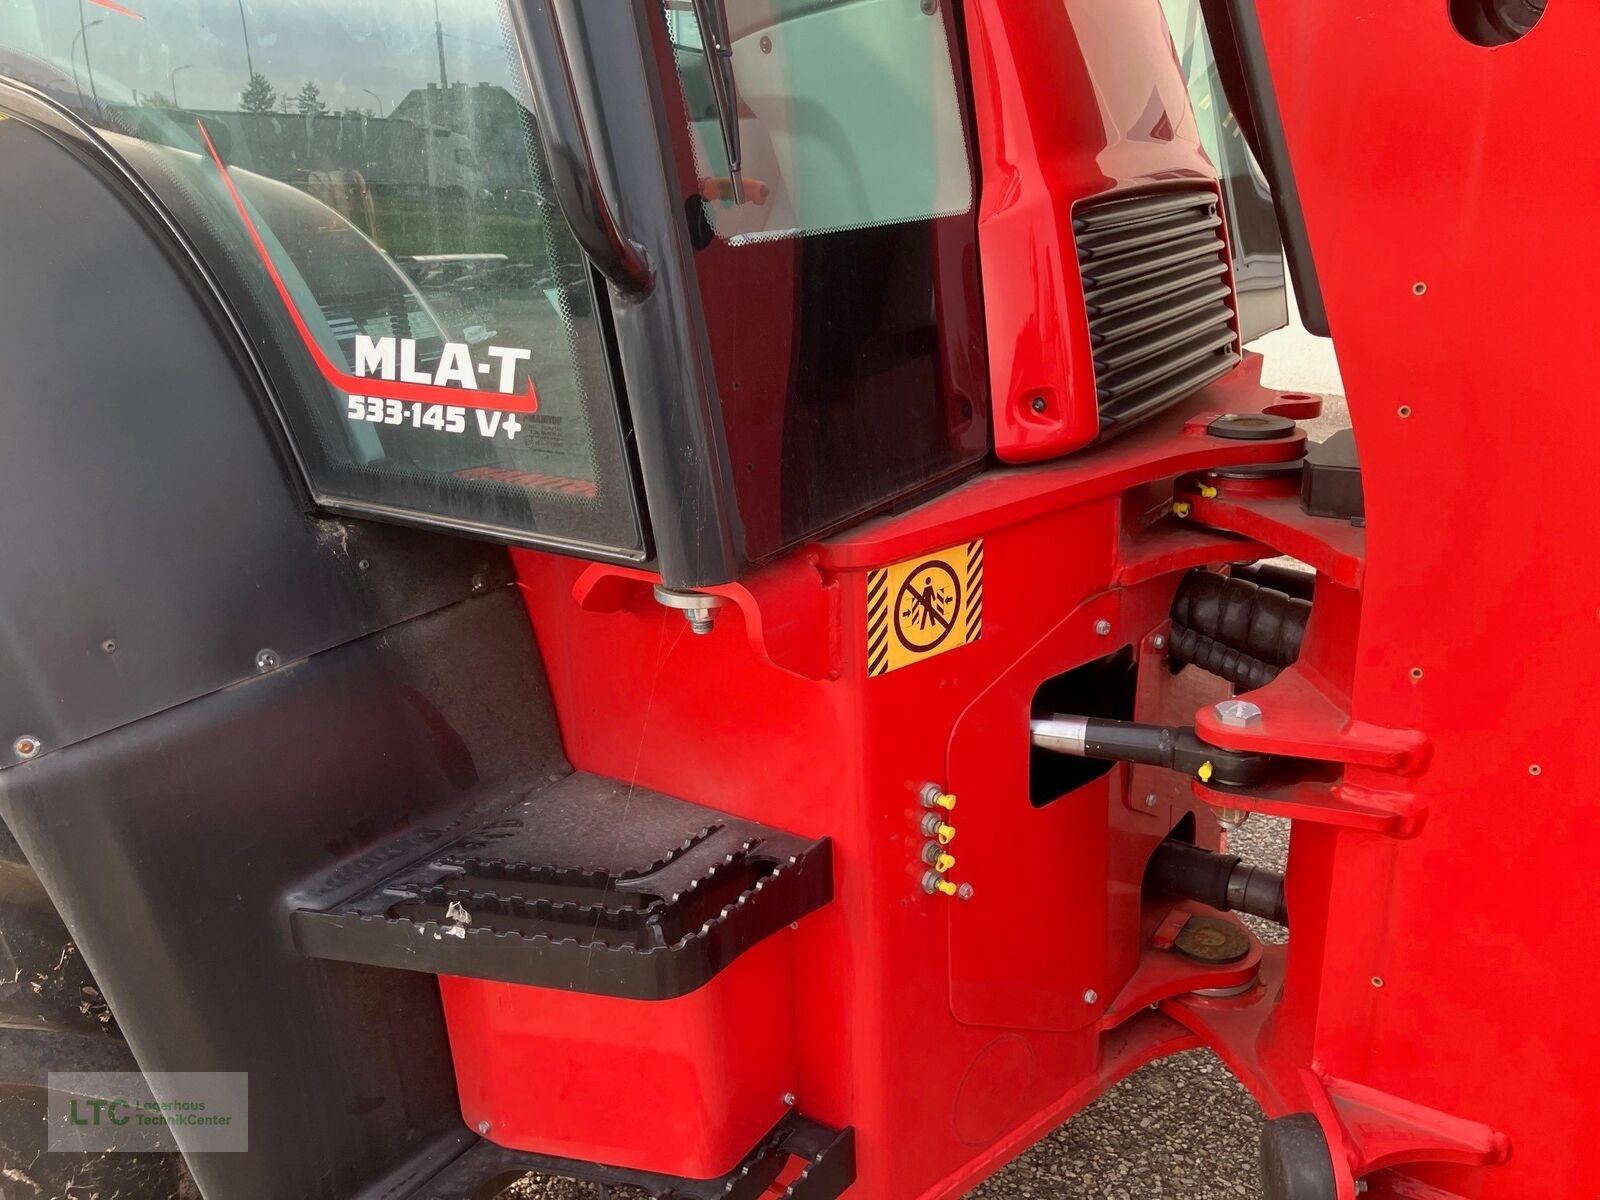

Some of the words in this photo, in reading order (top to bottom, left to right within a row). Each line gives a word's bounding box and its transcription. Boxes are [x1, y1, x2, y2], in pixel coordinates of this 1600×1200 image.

[355, 334, 531, 394] MLA-T
[348, 394, 466, 433] 533-145
[475, 409, 522, 440] V+
